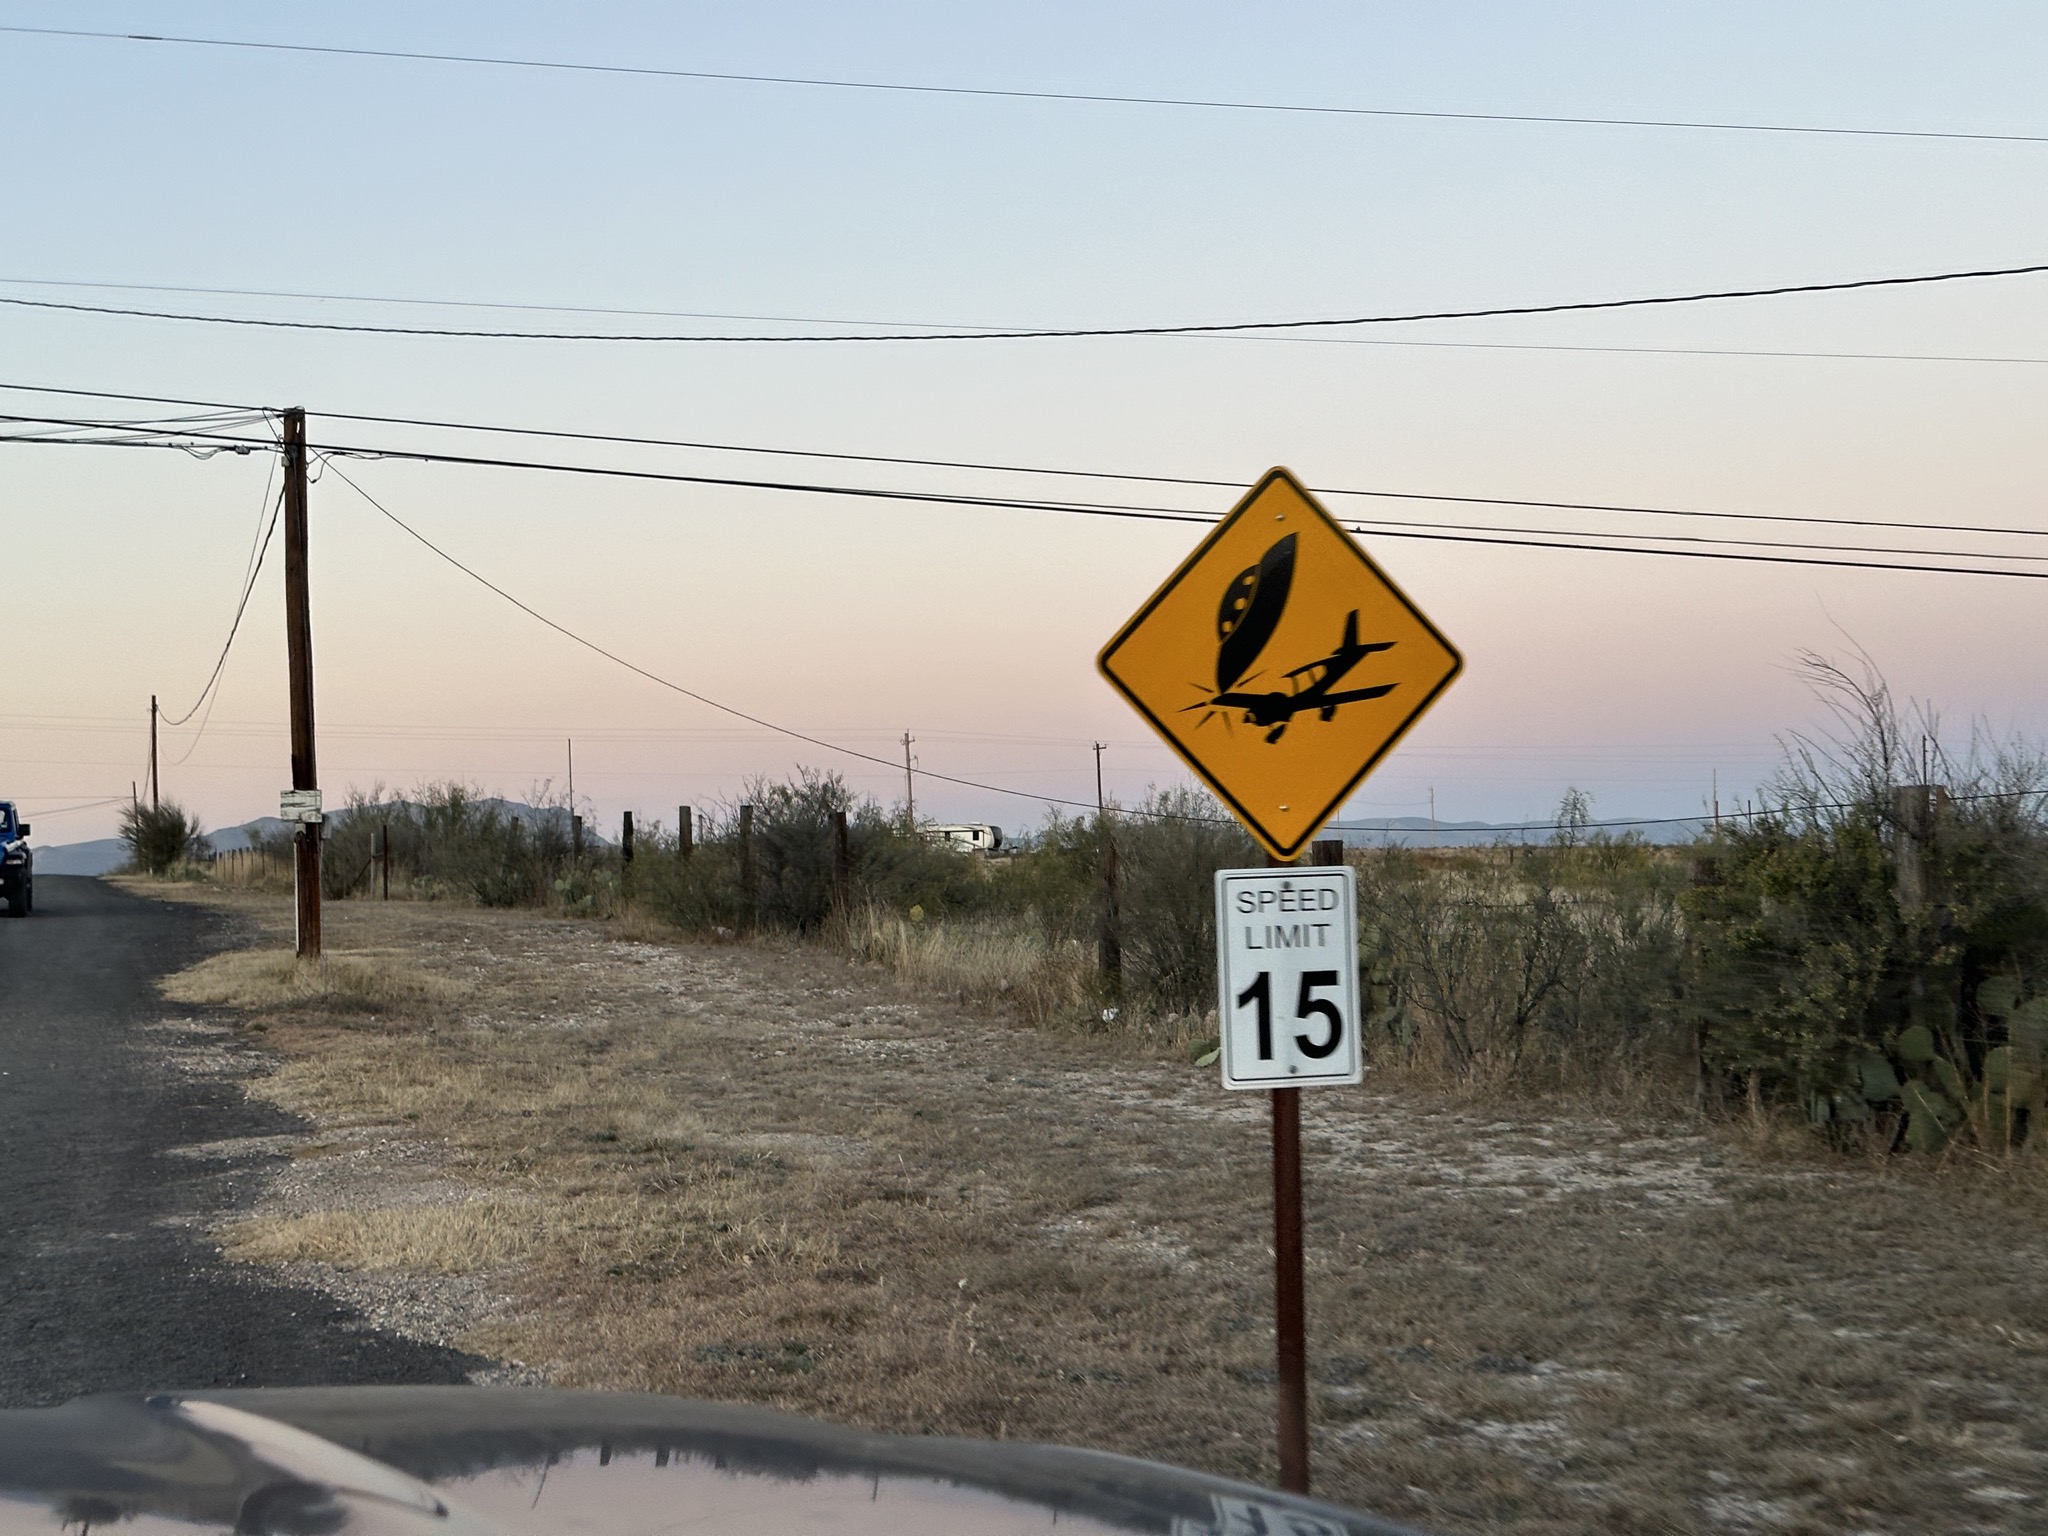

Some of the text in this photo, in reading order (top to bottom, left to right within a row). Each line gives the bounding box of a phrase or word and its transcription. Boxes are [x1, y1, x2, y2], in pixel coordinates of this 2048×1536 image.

[1236, 888, 1340, 914] SPEED
[1245, 923, 1331, 950] LIMIT
[1237, 970, 1343, 1060] 15
